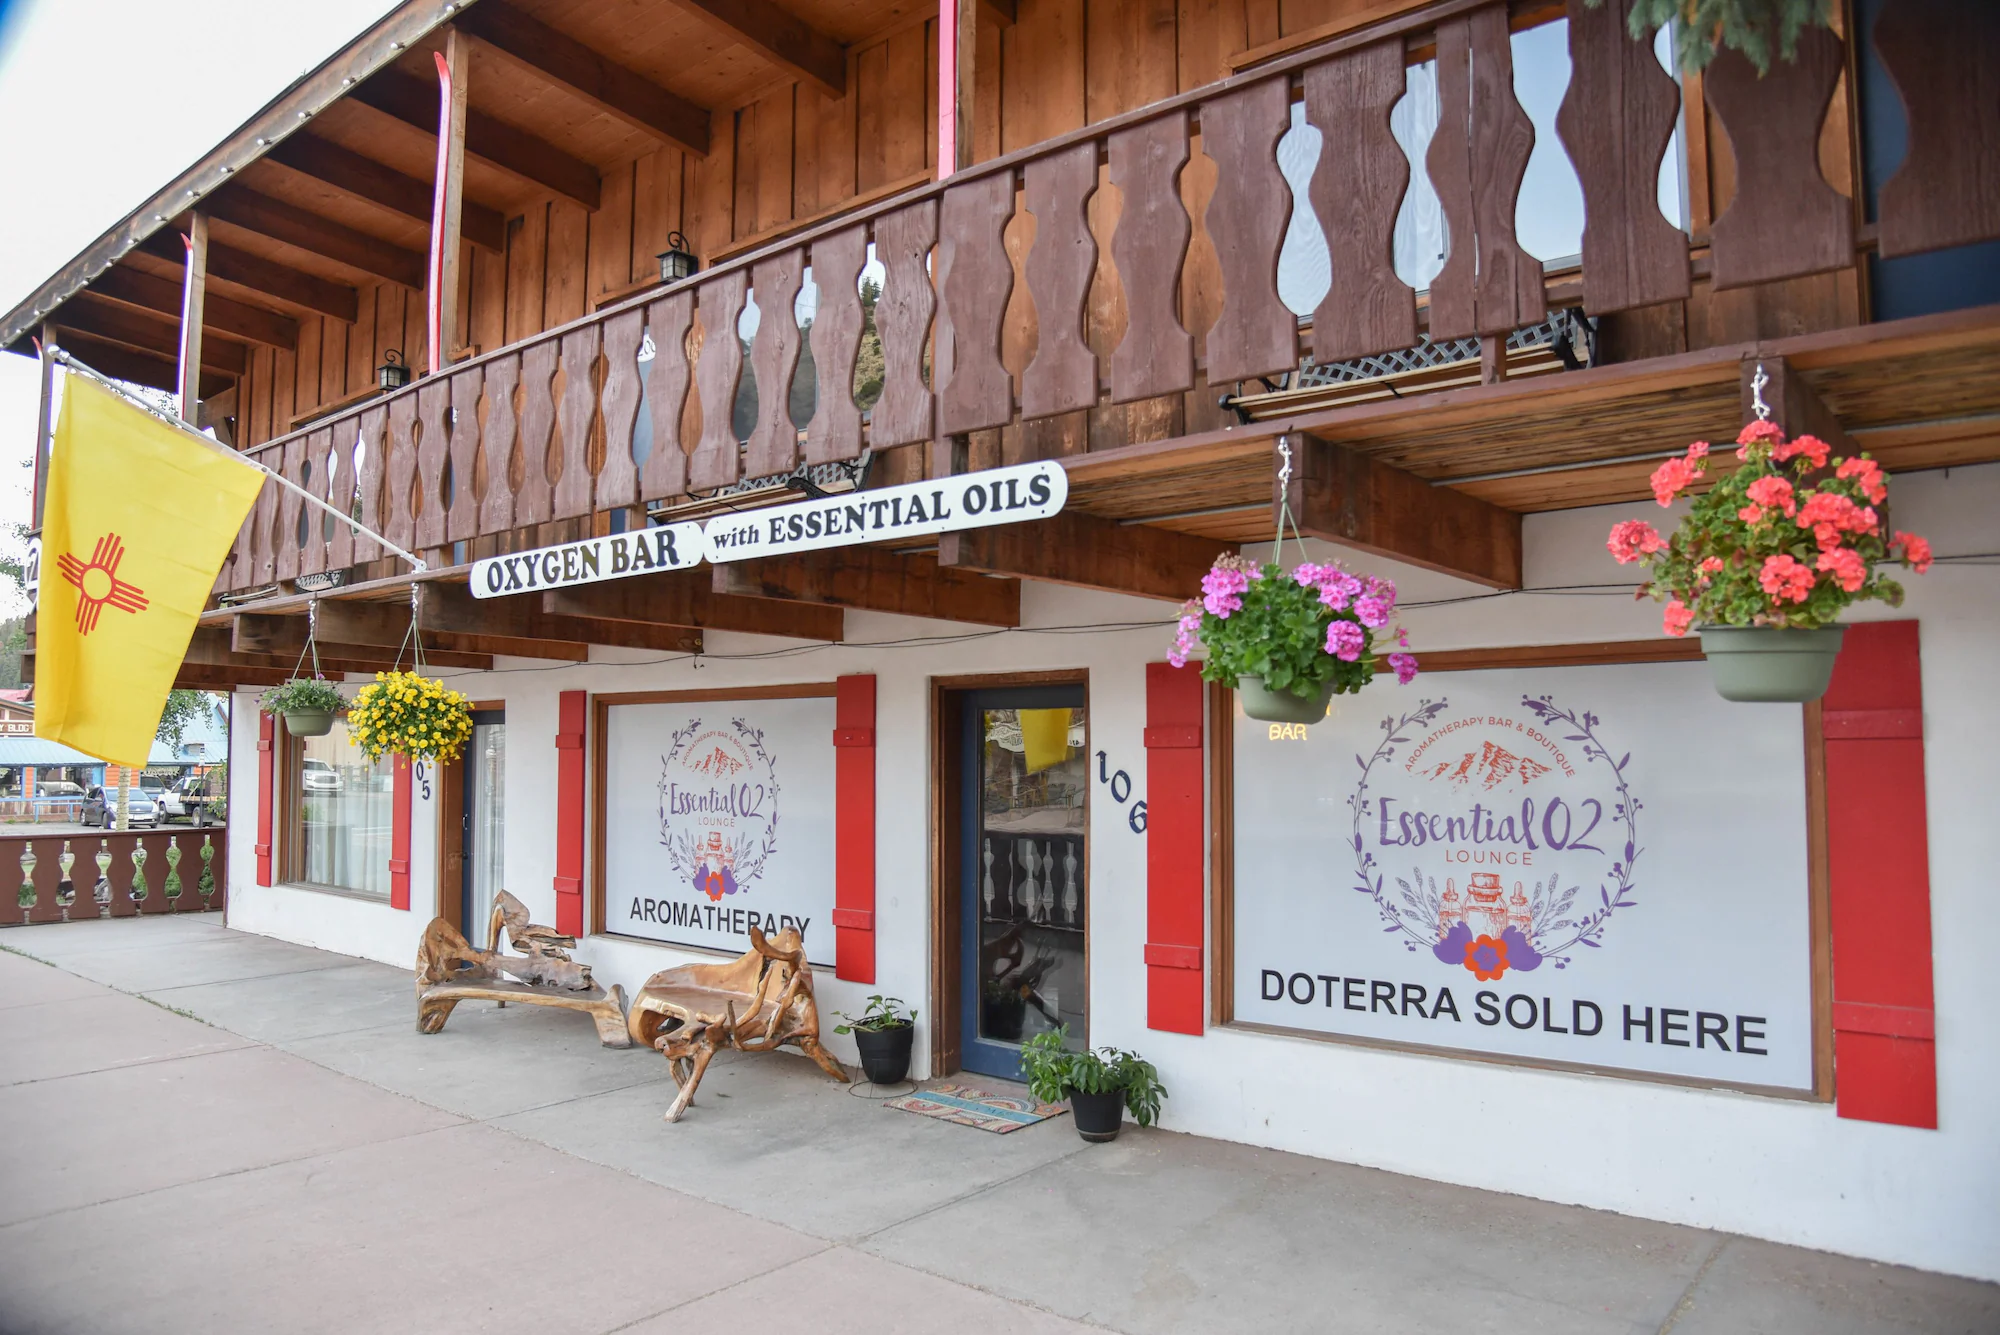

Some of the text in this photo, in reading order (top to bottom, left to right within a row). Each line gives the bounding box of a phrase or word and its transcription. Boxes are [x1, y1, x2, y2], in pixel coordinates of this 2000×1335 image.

[713, 473, 1052, 548] with ESSENTIAL OILS
[486, 529, 680, 594] OXYGEN BAR
[682, 730, 717, 767] AROMATHERAPY
[717, 730, 728, 738] BAR
[733, 738, 754, 771] BOUTIQUE
[1268, 722, 1307, 741] BAR
[1404, 716, 1576, 778] AROMATHERAPY BAR & BOUTIQUE
[415, 760, 431, 801] 05
[670, 782, 738, 817] Essential
[1095, 750, 1148, 834] 106
[698, 816, 736, 828] LOUNGE
[1379, 796, 1540, 851] Essential
[1445, 849, 1533, 866] LOUNGE
[1261, 969, 1769, 1056] DOTERRA SOLD HERE
